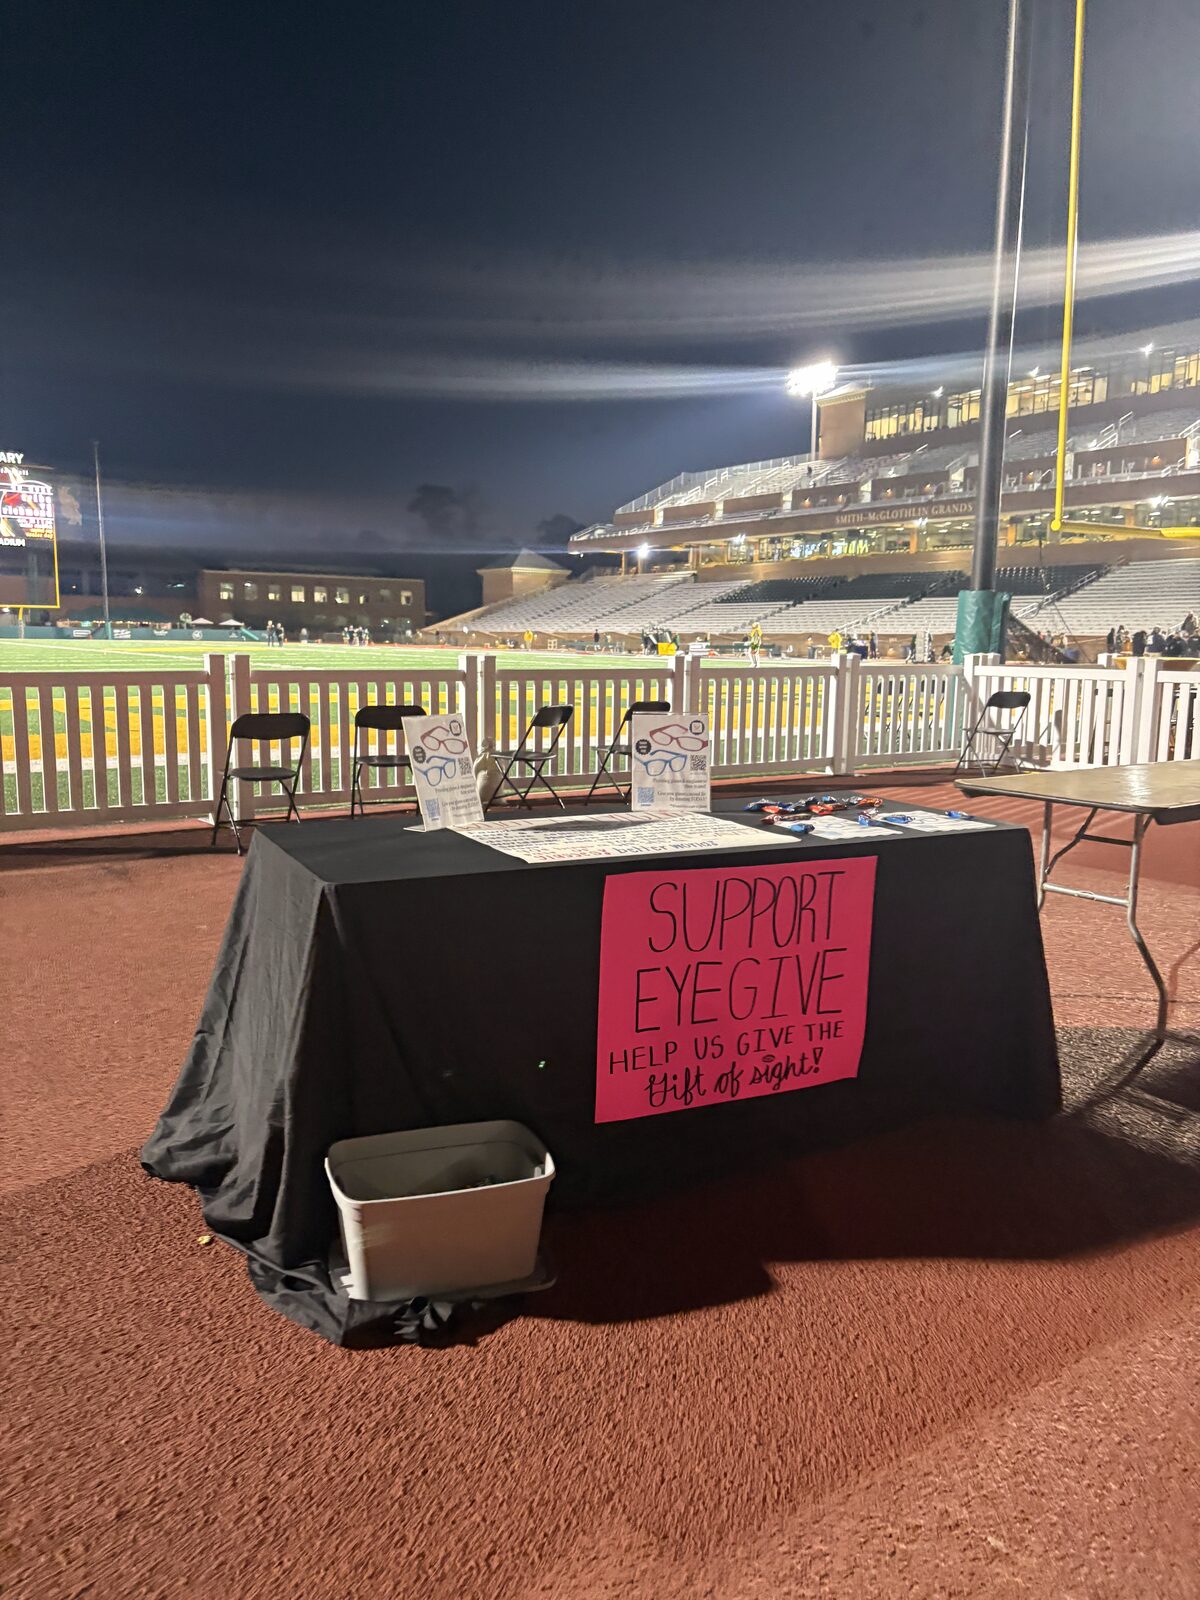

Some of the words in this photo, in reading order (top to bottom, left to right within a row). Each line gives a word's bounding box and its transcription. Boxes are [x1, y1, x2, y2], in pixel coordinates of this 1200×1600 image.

[931, 503, 973, 515] GRANDS
[648, 870, 846, 953] SUPPORT
[634, 947, 848, 1034] EYEGIVE
[609, 1040, 678, 1075] HELP
[693, 1034, 725, 1061] US
[736, 1024, 796, 1057] GIVE
[804, 1020, 845, 1042] THE
[643, 1065, 707, 1108] Gift
[713, 1060, 745, 1098] of
[749, 1046, 824, 1091] sight!
